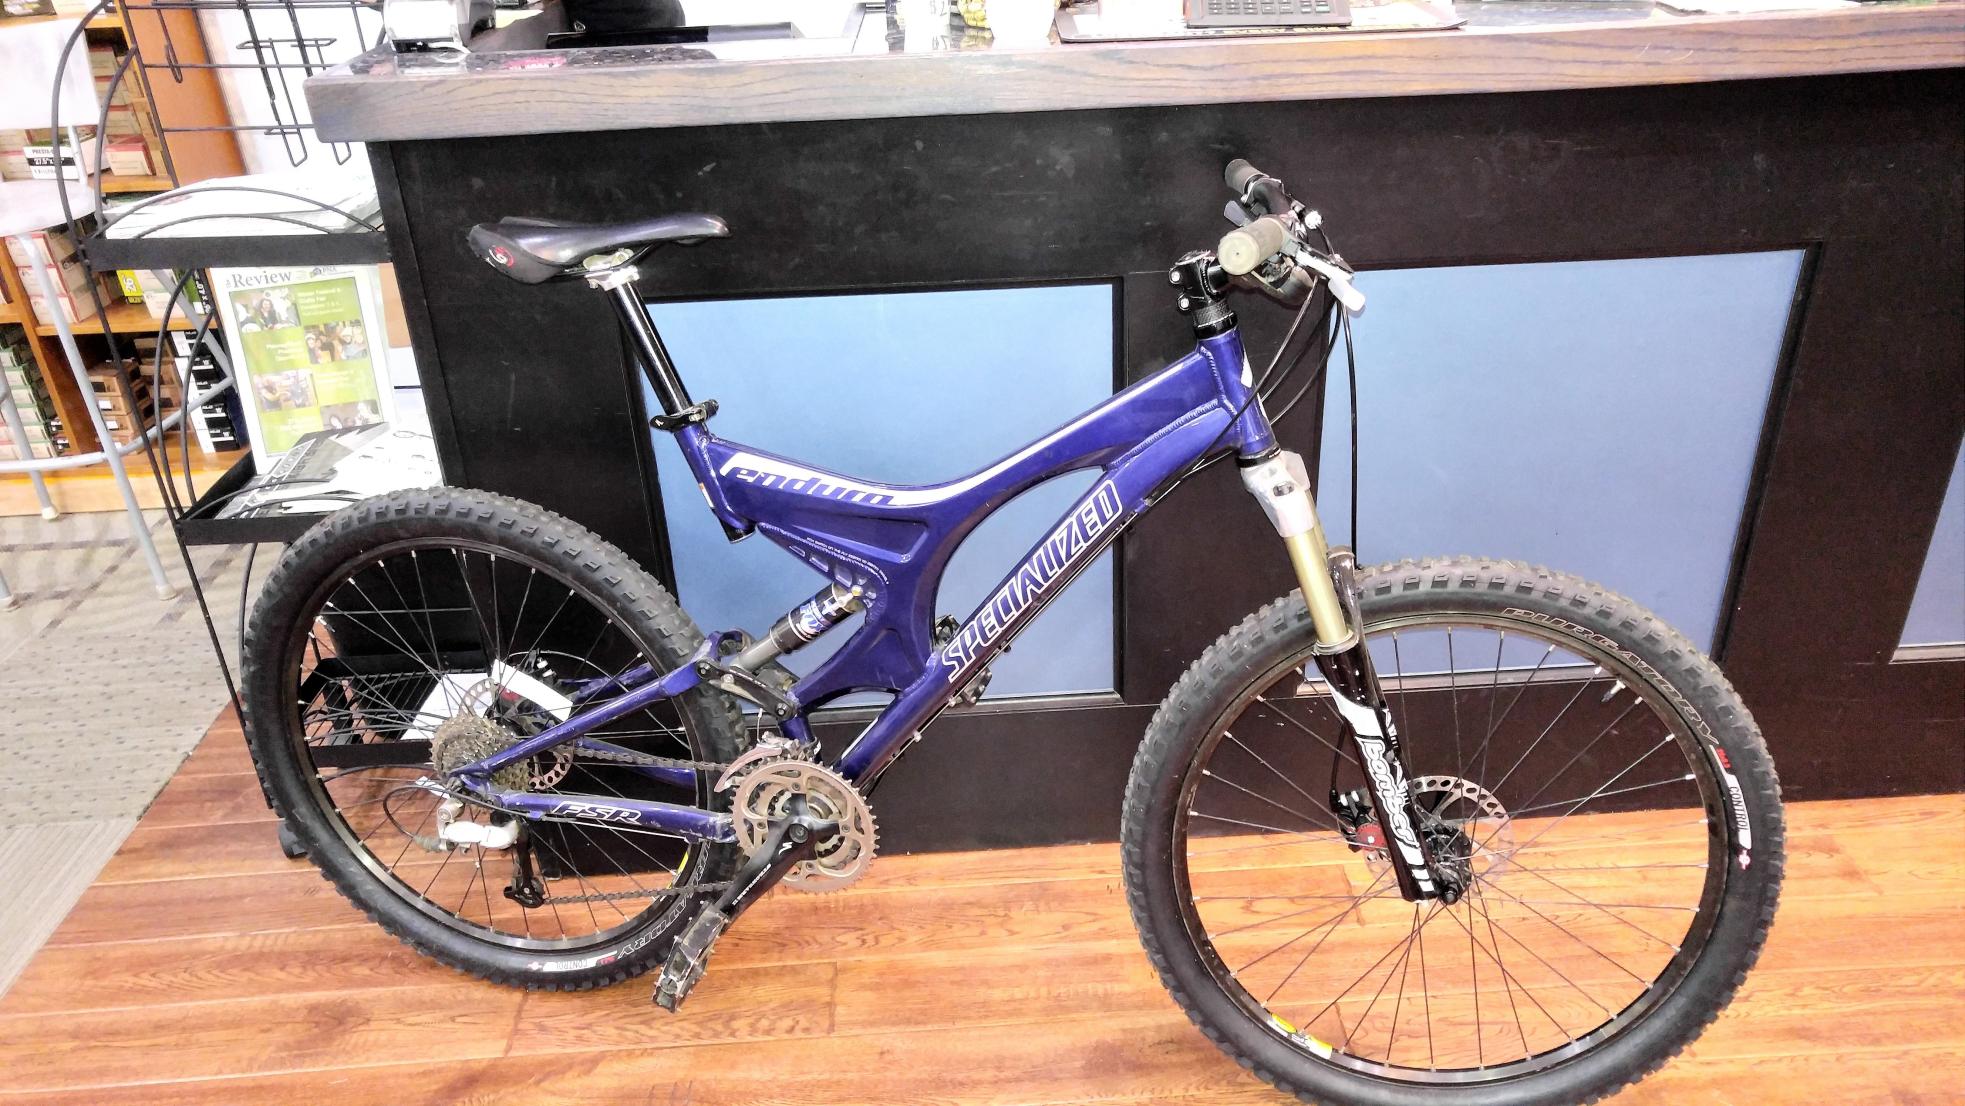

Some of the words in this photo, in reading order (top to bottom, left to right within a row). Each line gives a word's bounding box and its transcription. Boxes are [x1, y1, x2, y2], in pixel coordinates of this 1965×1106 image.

[231, 270, 292, 289] Review
[942, 479, 1123, 684] SPECIALIZED
[1501, 606, 1720, 745] PURGATORY
[551, 800, 642, 826] FSR
[1359, 739, 1419, 846] bomber
